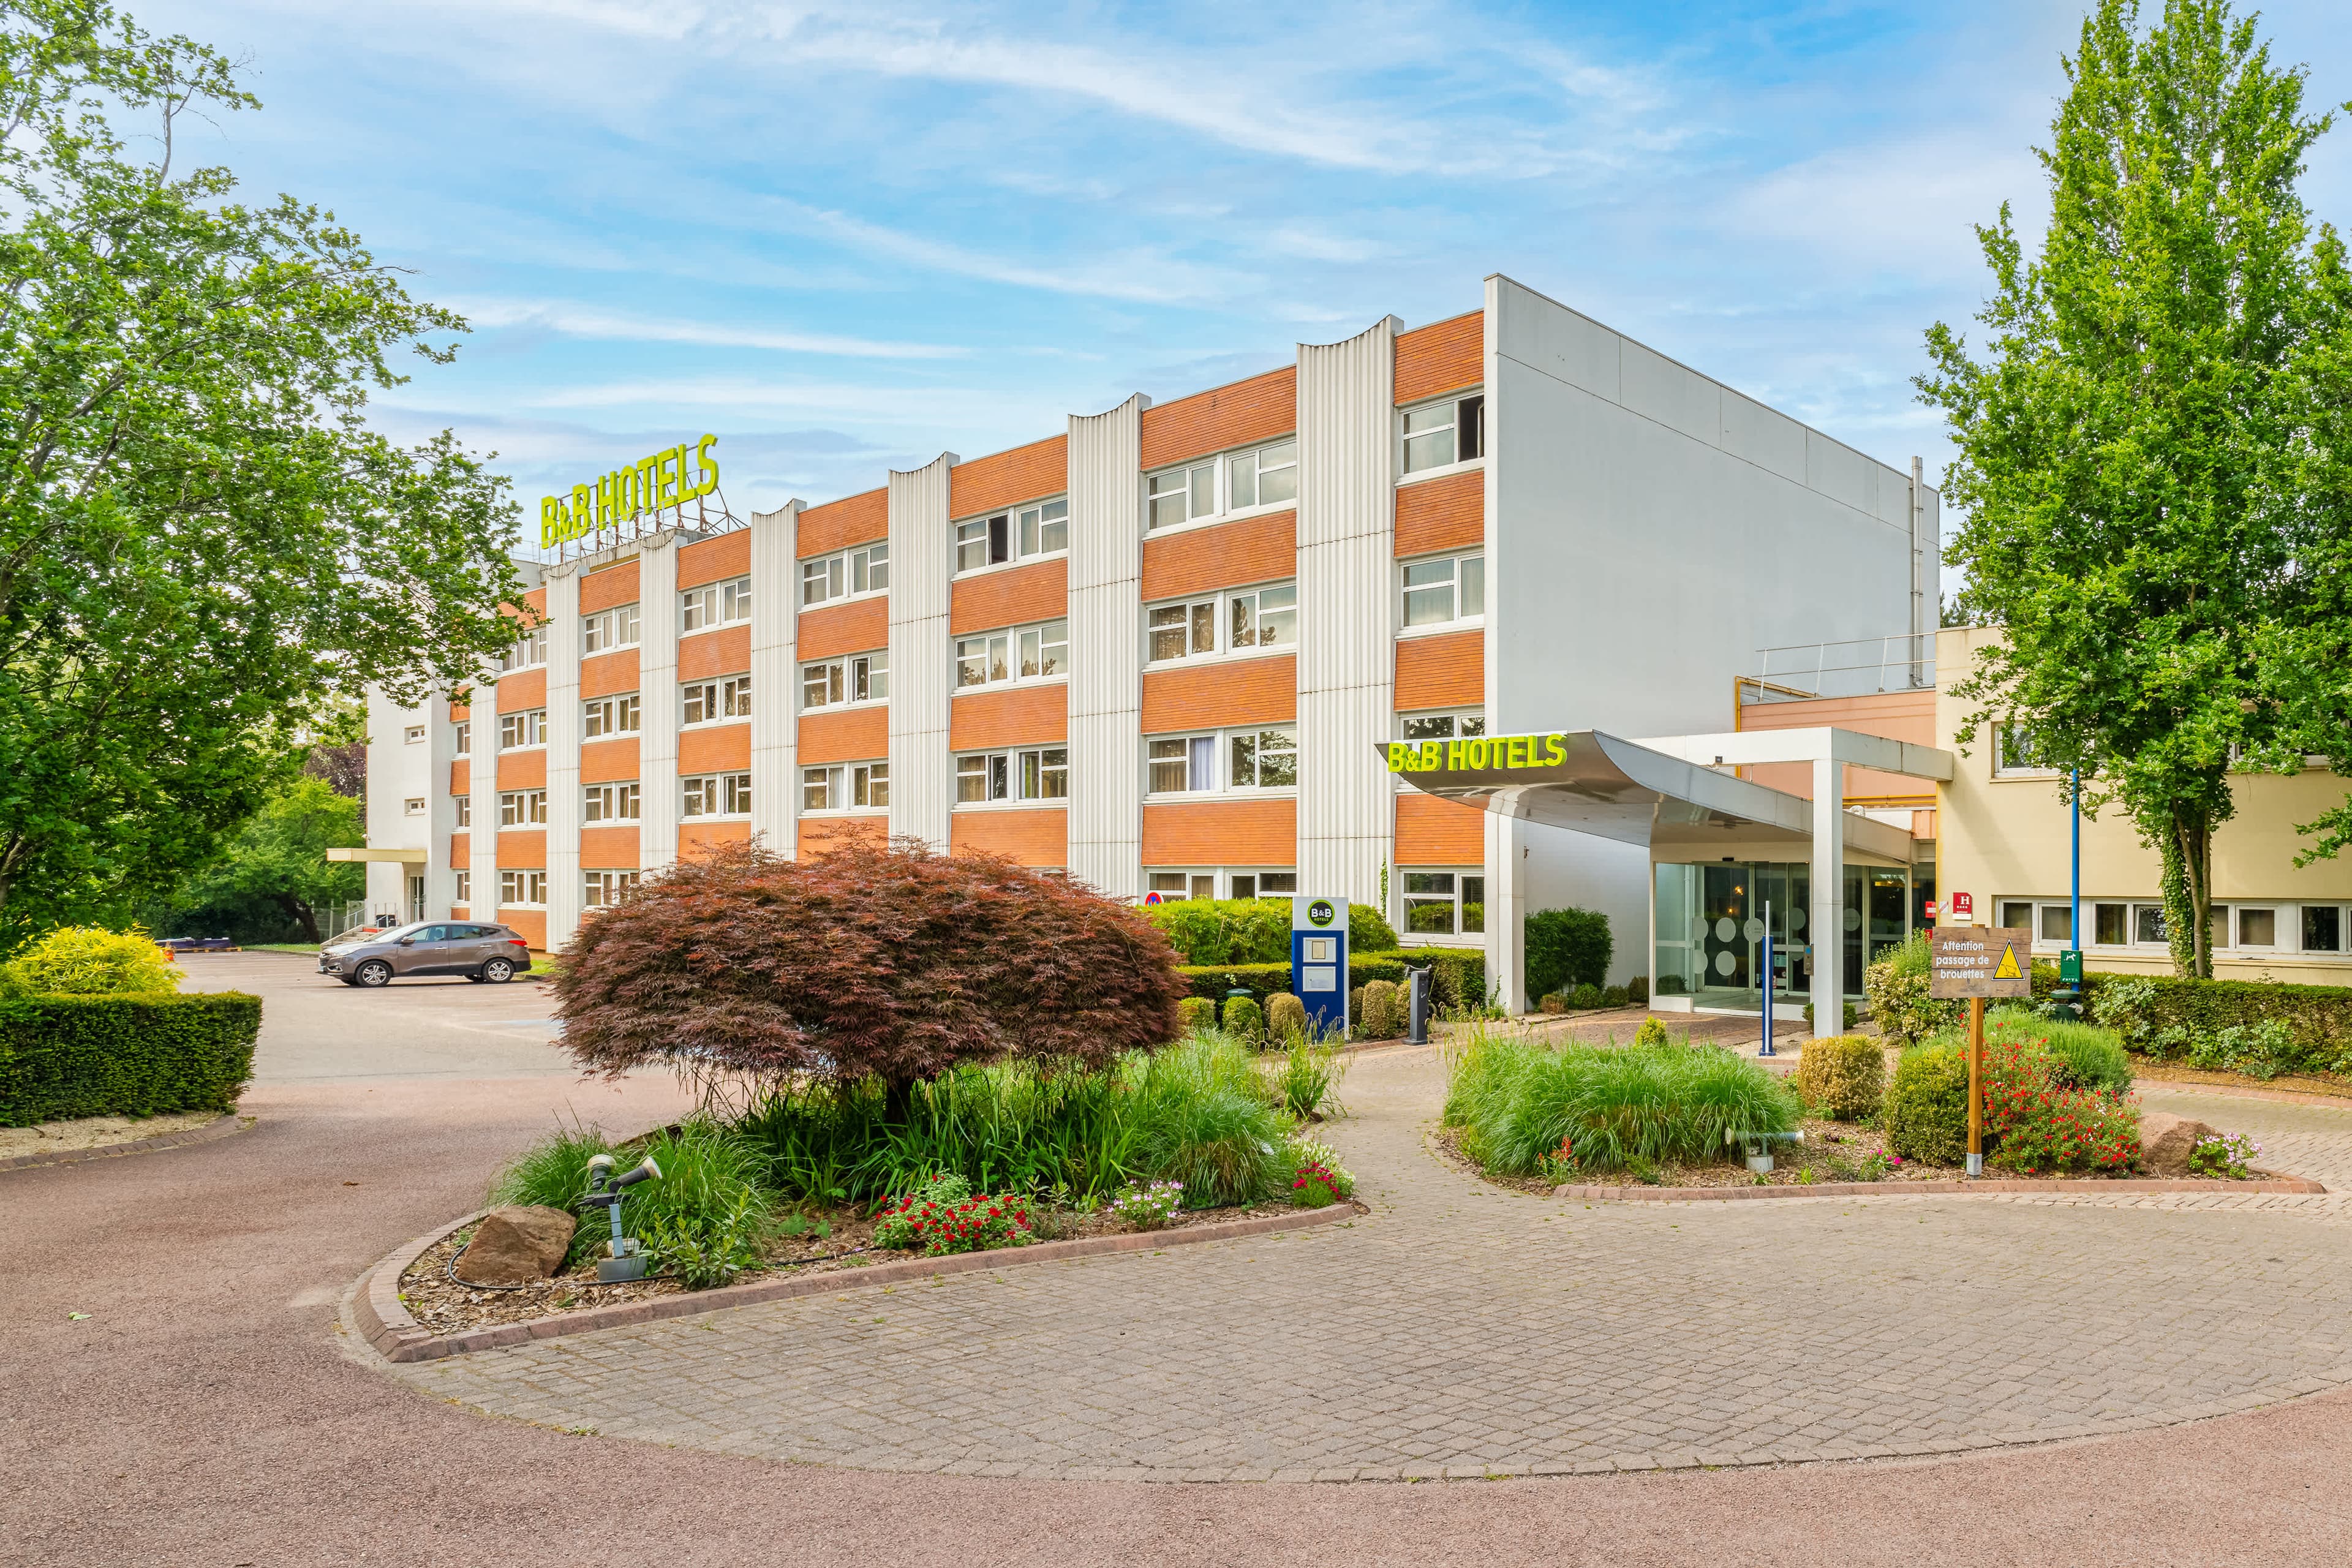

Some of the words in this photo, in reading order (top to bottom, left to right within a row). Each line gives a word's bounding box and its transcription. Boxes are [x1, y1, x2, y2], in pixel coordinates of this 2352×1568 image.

[541, 483, 591, 549] B&B
[598, 434, 719, 530] HOTELS
[1388, 741, 1442, 772] B&B
[1448, 733, 1568, 771] HOTELS
[1960, 895, 1970, 905] H
[1311, 908, 1332, 918] B&B
[1942, 940, 1984, 951] Attention
[1936, 956, 1975, 967] passage
[1977, 955, 1990, 965] de
[1940, 969, 1985, 979] brouettes
